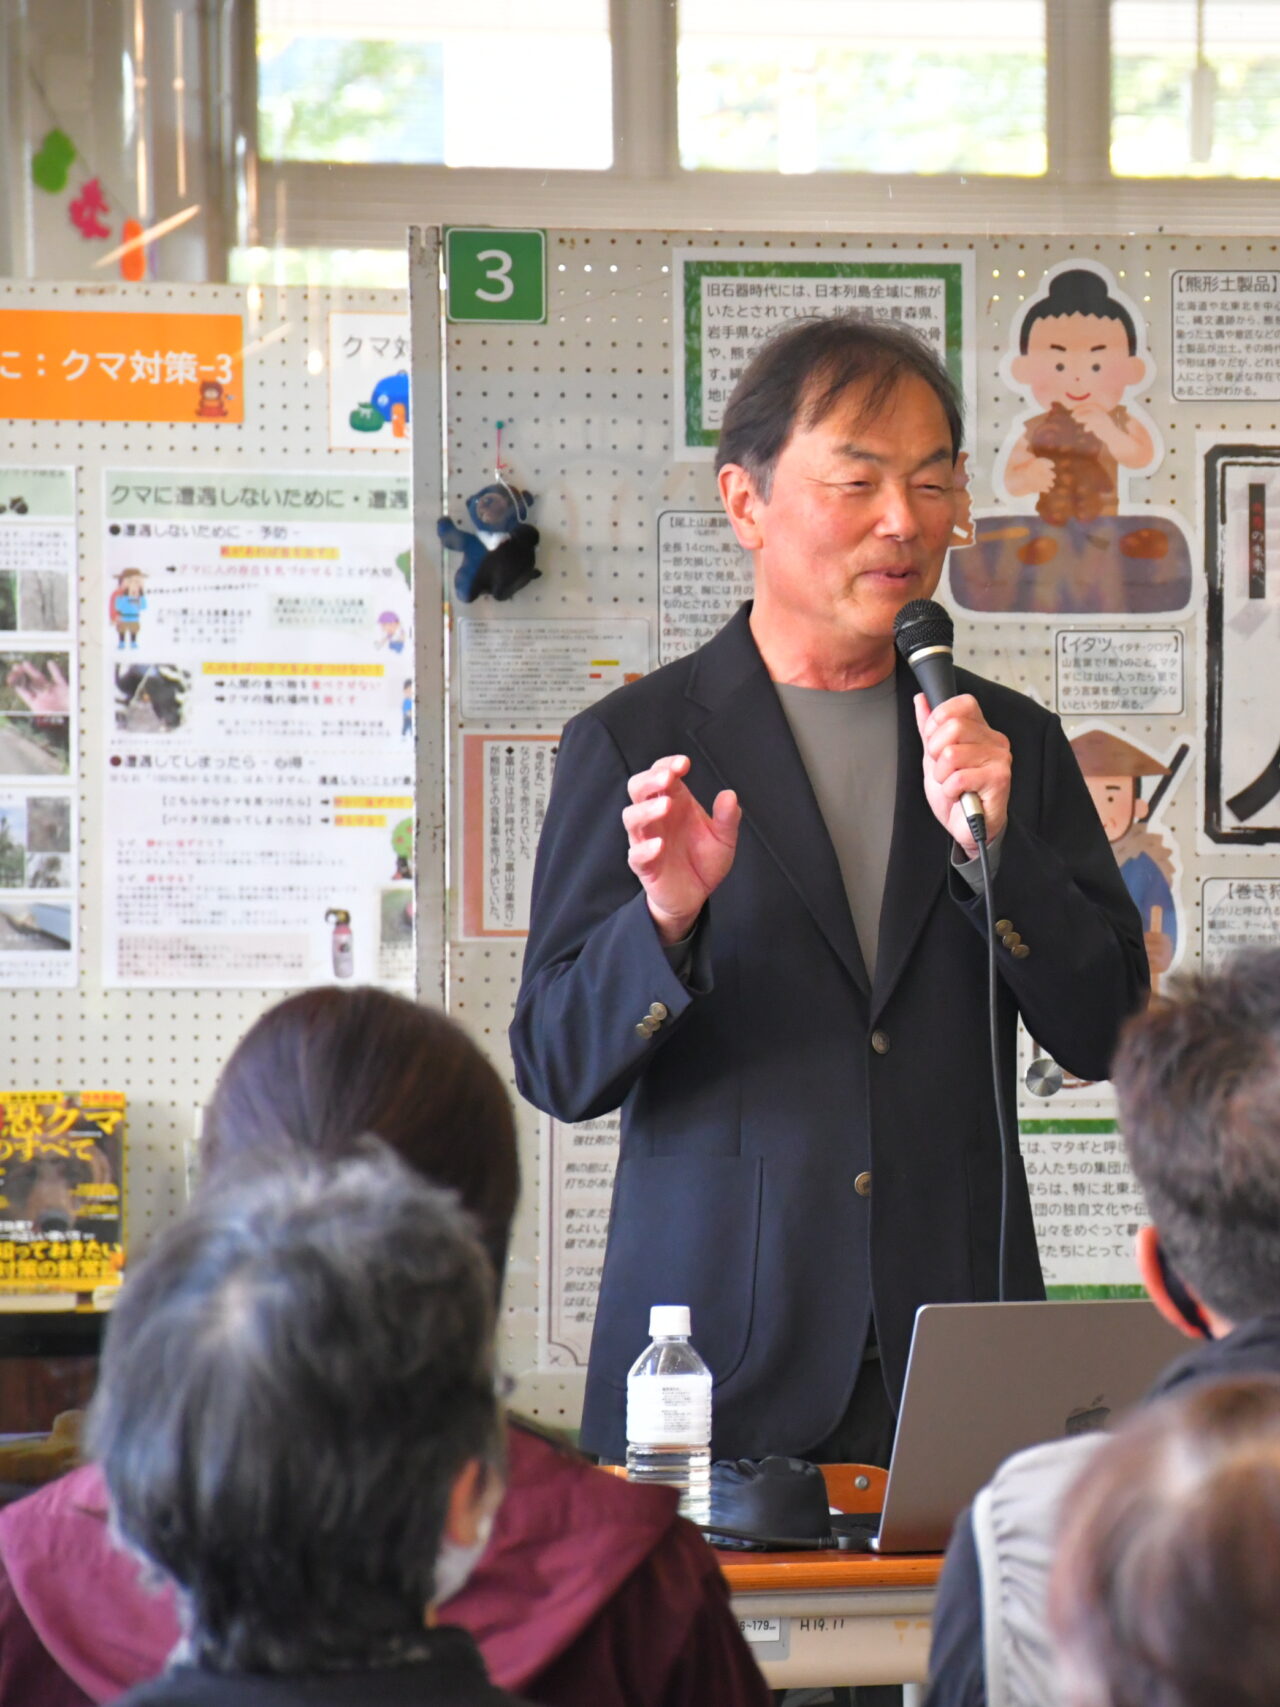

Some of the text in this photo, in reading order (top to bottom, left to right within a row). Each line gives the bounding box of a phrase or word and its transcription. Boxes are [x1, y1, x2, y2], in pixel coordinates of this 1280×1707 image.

[475, 249, 514, 302] 3
[1178, 275, 1278, 293] 【熊形土製品】
[707, 283, 941, 298] 旧石器時代には、日本列島全域に熊が
